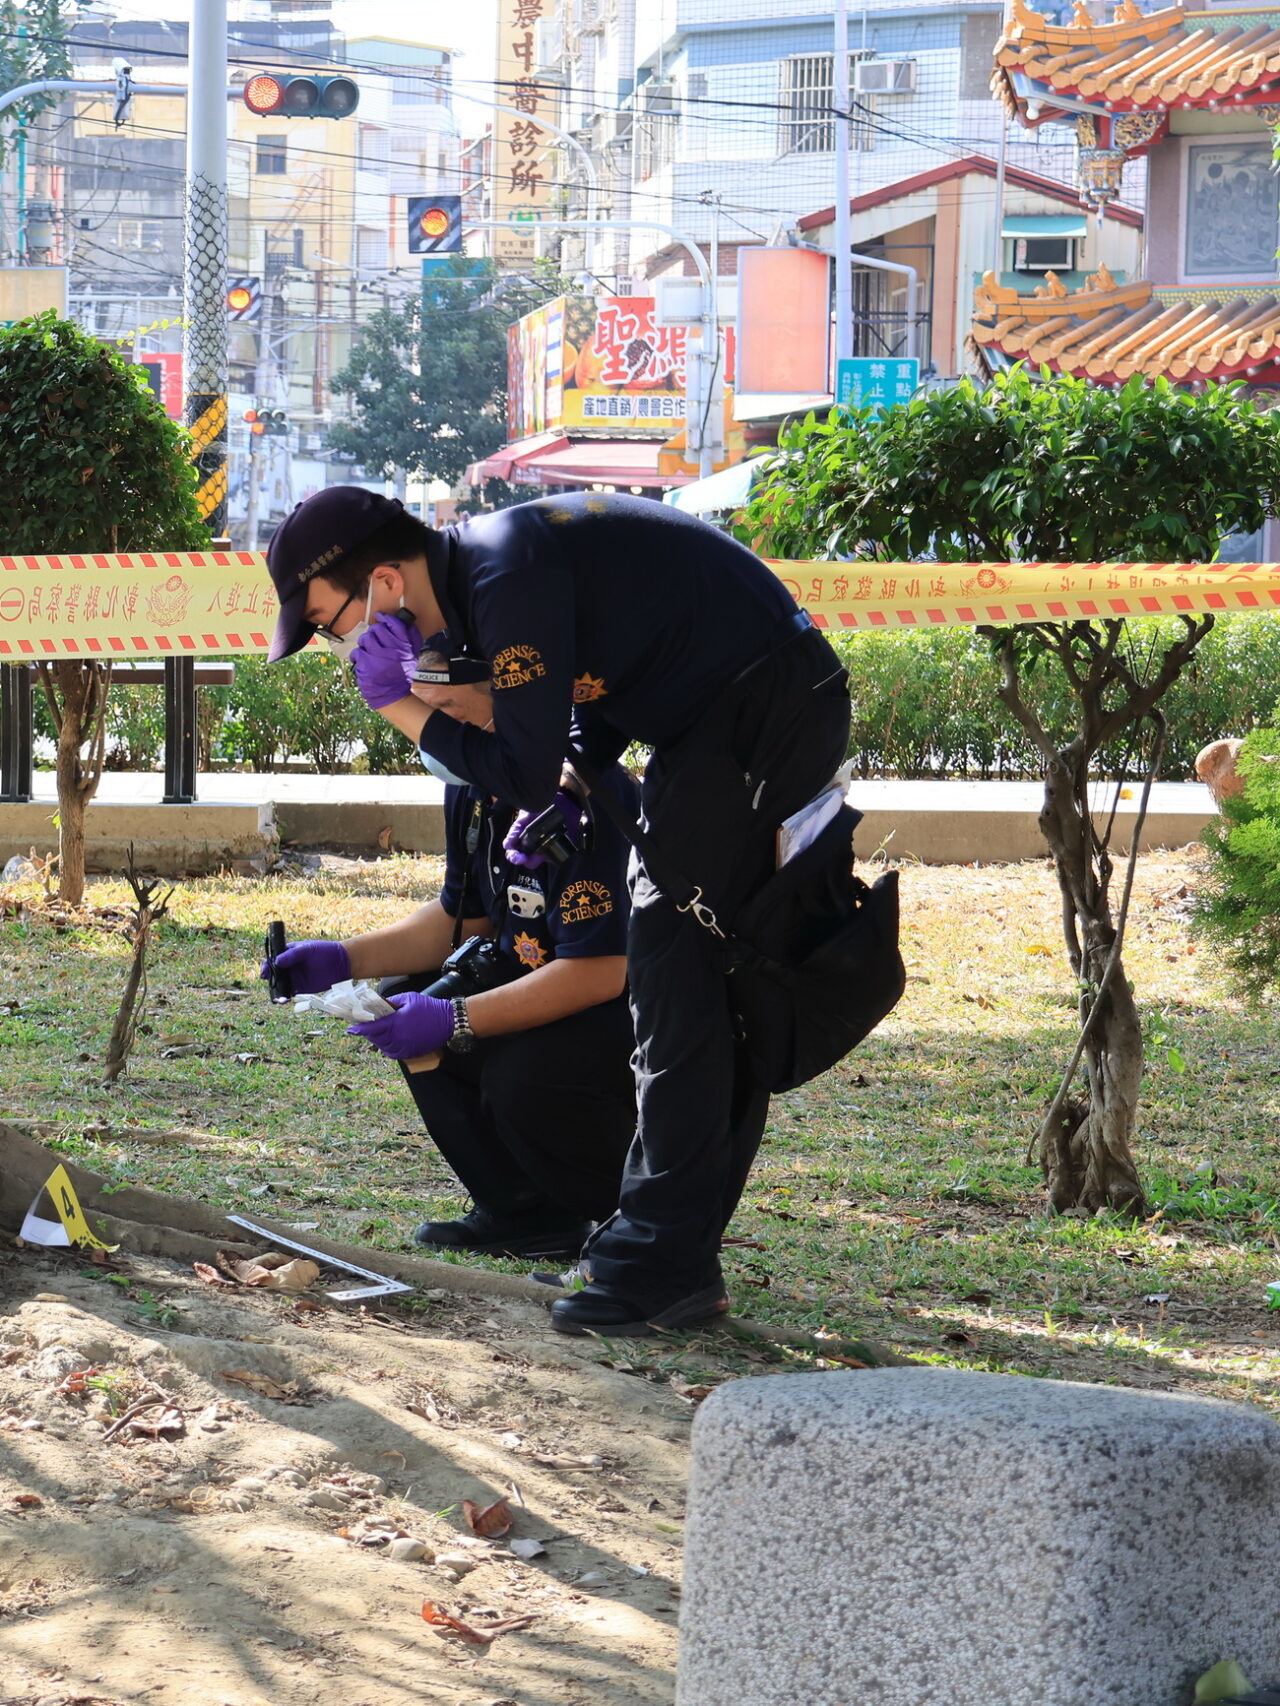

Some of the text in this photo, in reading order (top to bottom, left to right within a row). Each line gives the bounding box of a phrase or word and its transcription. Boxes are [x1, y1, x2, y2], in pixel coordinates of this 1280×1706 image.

[593, 306, 736, 387] 聖鴻
[493, 645, 541, 674] FORENSIC
[493, 662, 547, 690] SCIENCE
[560, 880, 611, 908] FORENSIC
[562, 901, 614, 924] SCIENCE
[61, 1187, 76, 1220] 4
